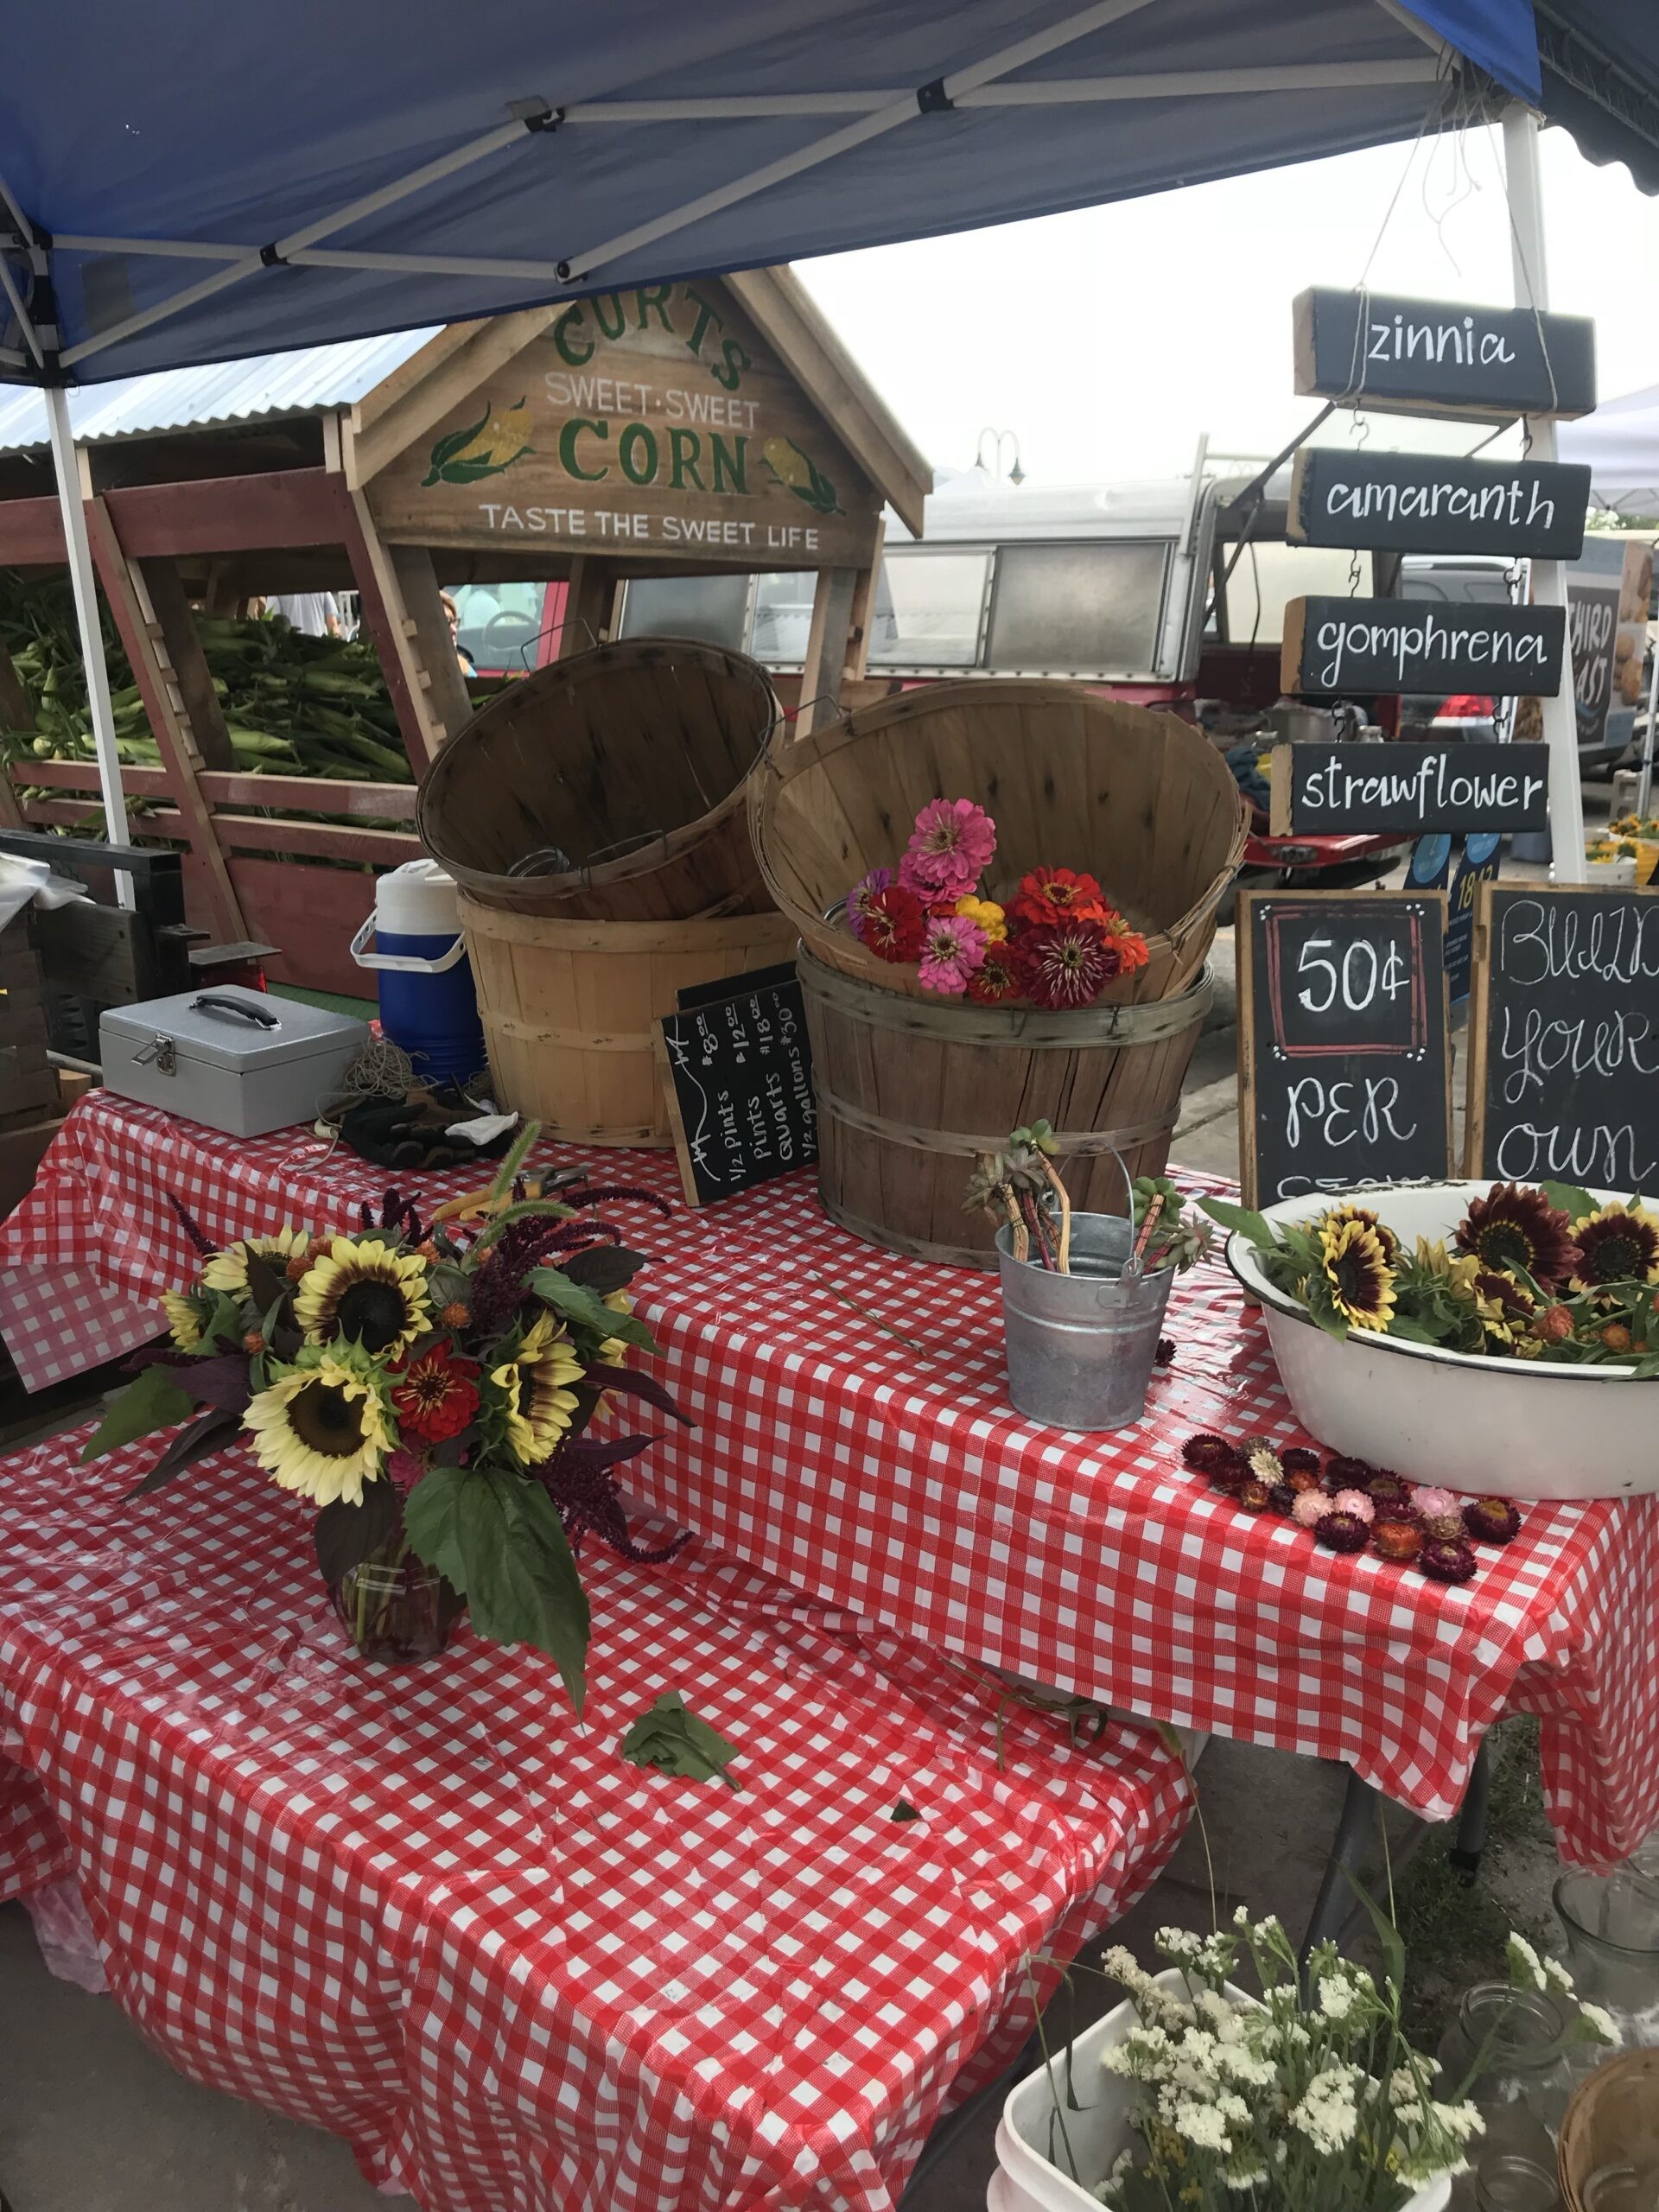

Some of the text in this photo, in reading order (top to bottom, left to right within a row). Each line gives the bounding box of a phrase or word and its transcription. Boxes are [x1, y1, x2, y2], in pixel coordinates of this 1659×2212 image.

[554, 286, 751, 391] CURTS
[1368, 315, 1515, 364] zinnia
[559, 418, 749, 494] CORN
[479, 504, 818, 550] TASTE THE SWEET LIFE
[1327, 480, 1554, 529] amaranth
[1318, 614, 1548, 688] gomphrena
[1568, 601, 1612, 657] THIRD
[1301, 753, 1543, 819] strawflower
[1298, 939, 1410, 1012] 50¢
[789, 1046, 817, 1124] gallons
